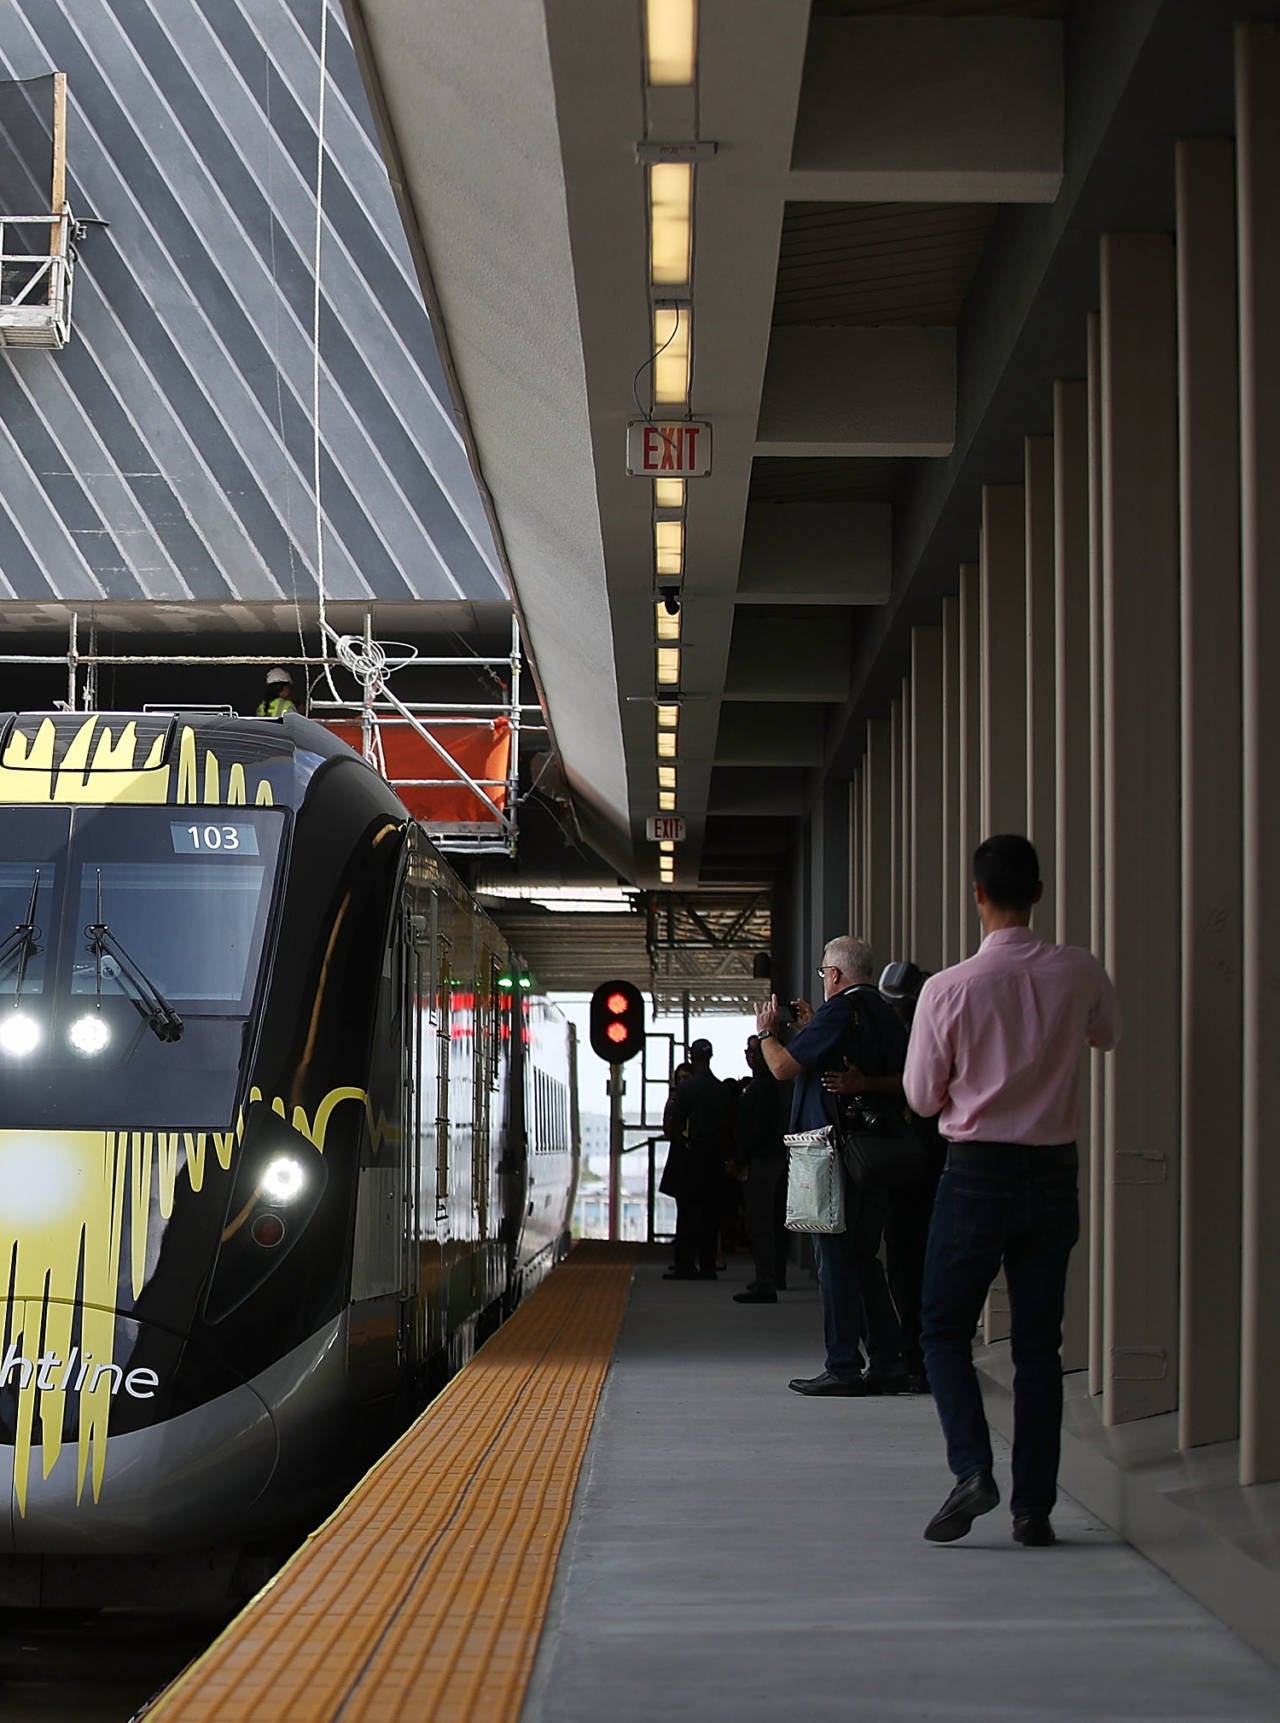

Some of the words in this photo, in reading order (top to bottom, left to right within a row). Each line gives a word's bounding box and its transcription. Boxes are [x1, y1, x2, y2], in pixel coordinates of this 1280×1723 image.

[643, 427, 700, 470] EXIT
[187, 826, 240, 849] 103
[654, 818, 680, 839] EXIT
